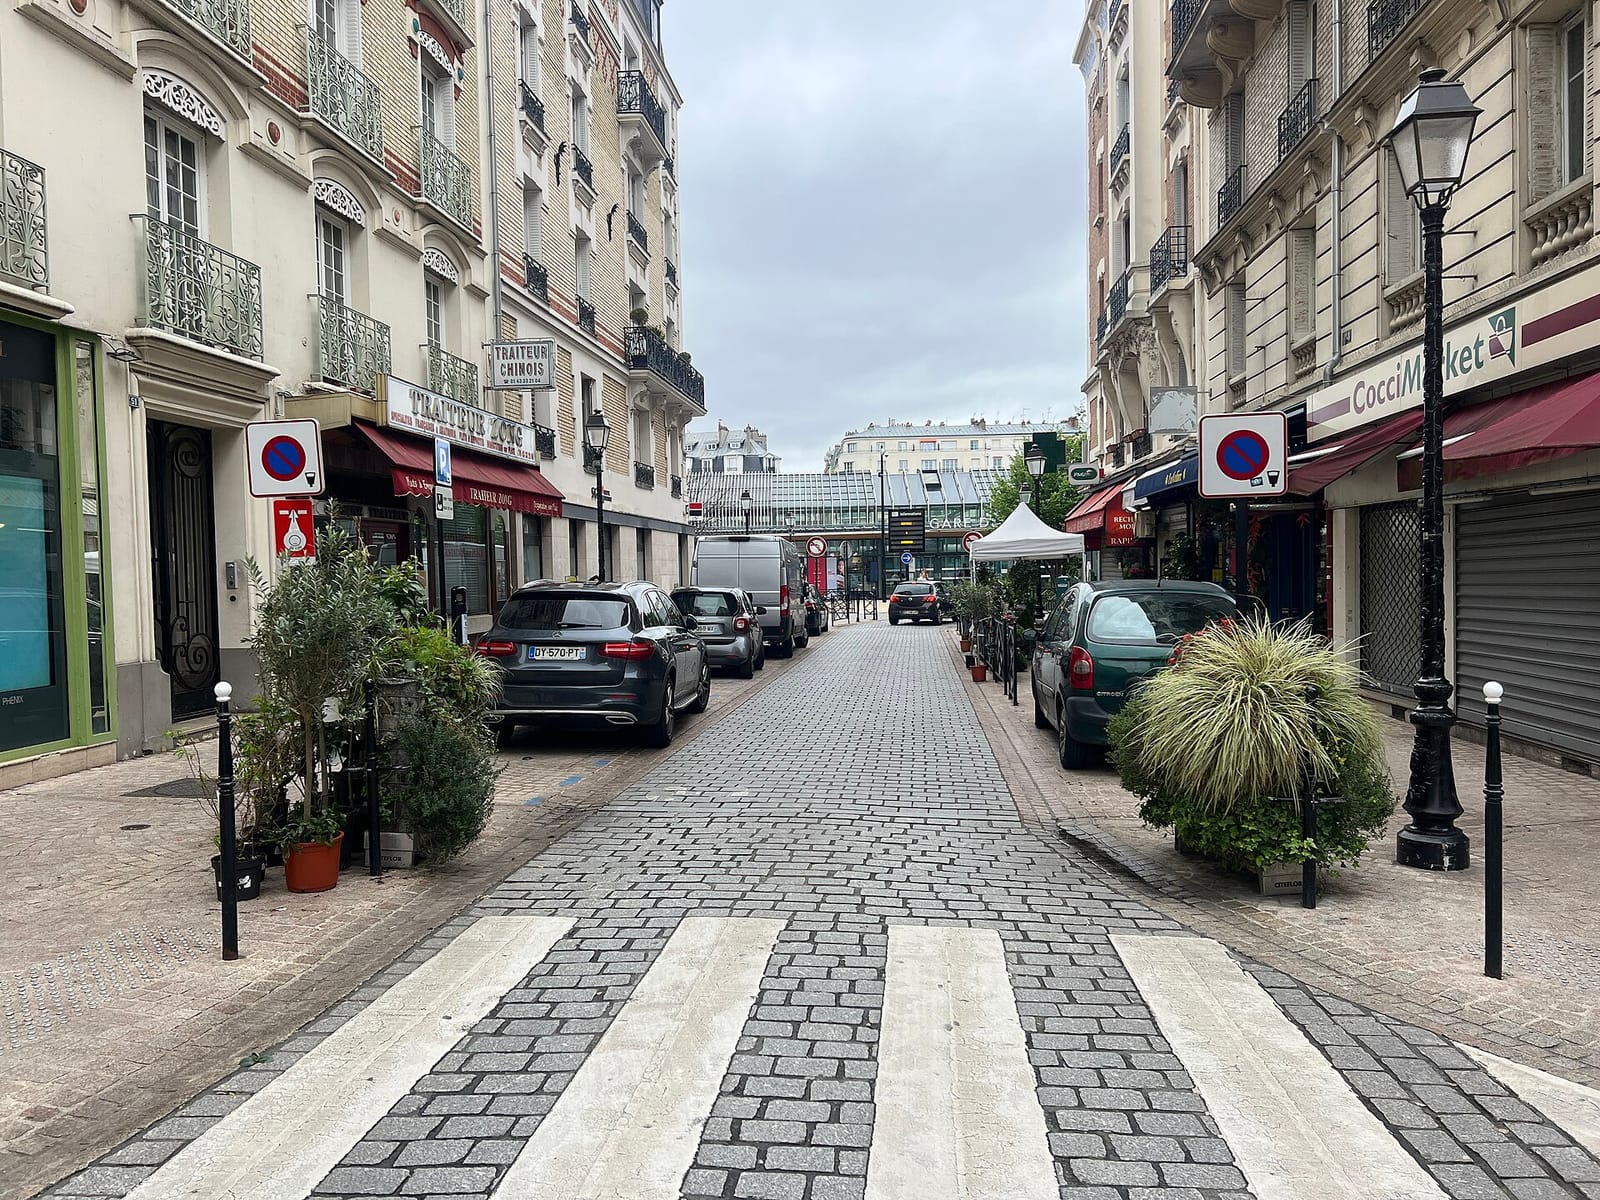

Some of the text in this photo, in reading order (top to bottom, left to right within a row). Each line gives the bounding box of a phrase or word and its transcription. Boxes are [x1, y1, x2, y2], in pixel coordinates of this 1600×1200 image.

[495, 345, 547, 360] TRAITEUR
[500, 362, 544, 377] CHINOIS
[1353, 332, 1485, 415] CocciMket
[408, 388, 524, 448] TRAITEUR ZONG
[470, 487, 513, 506] TRAITEUR ZONG
[929, 518, 972, 529] GARE
[535, 648, 580, 657] DY-570-PT
[2, 695, 25, 706] PHENIX
